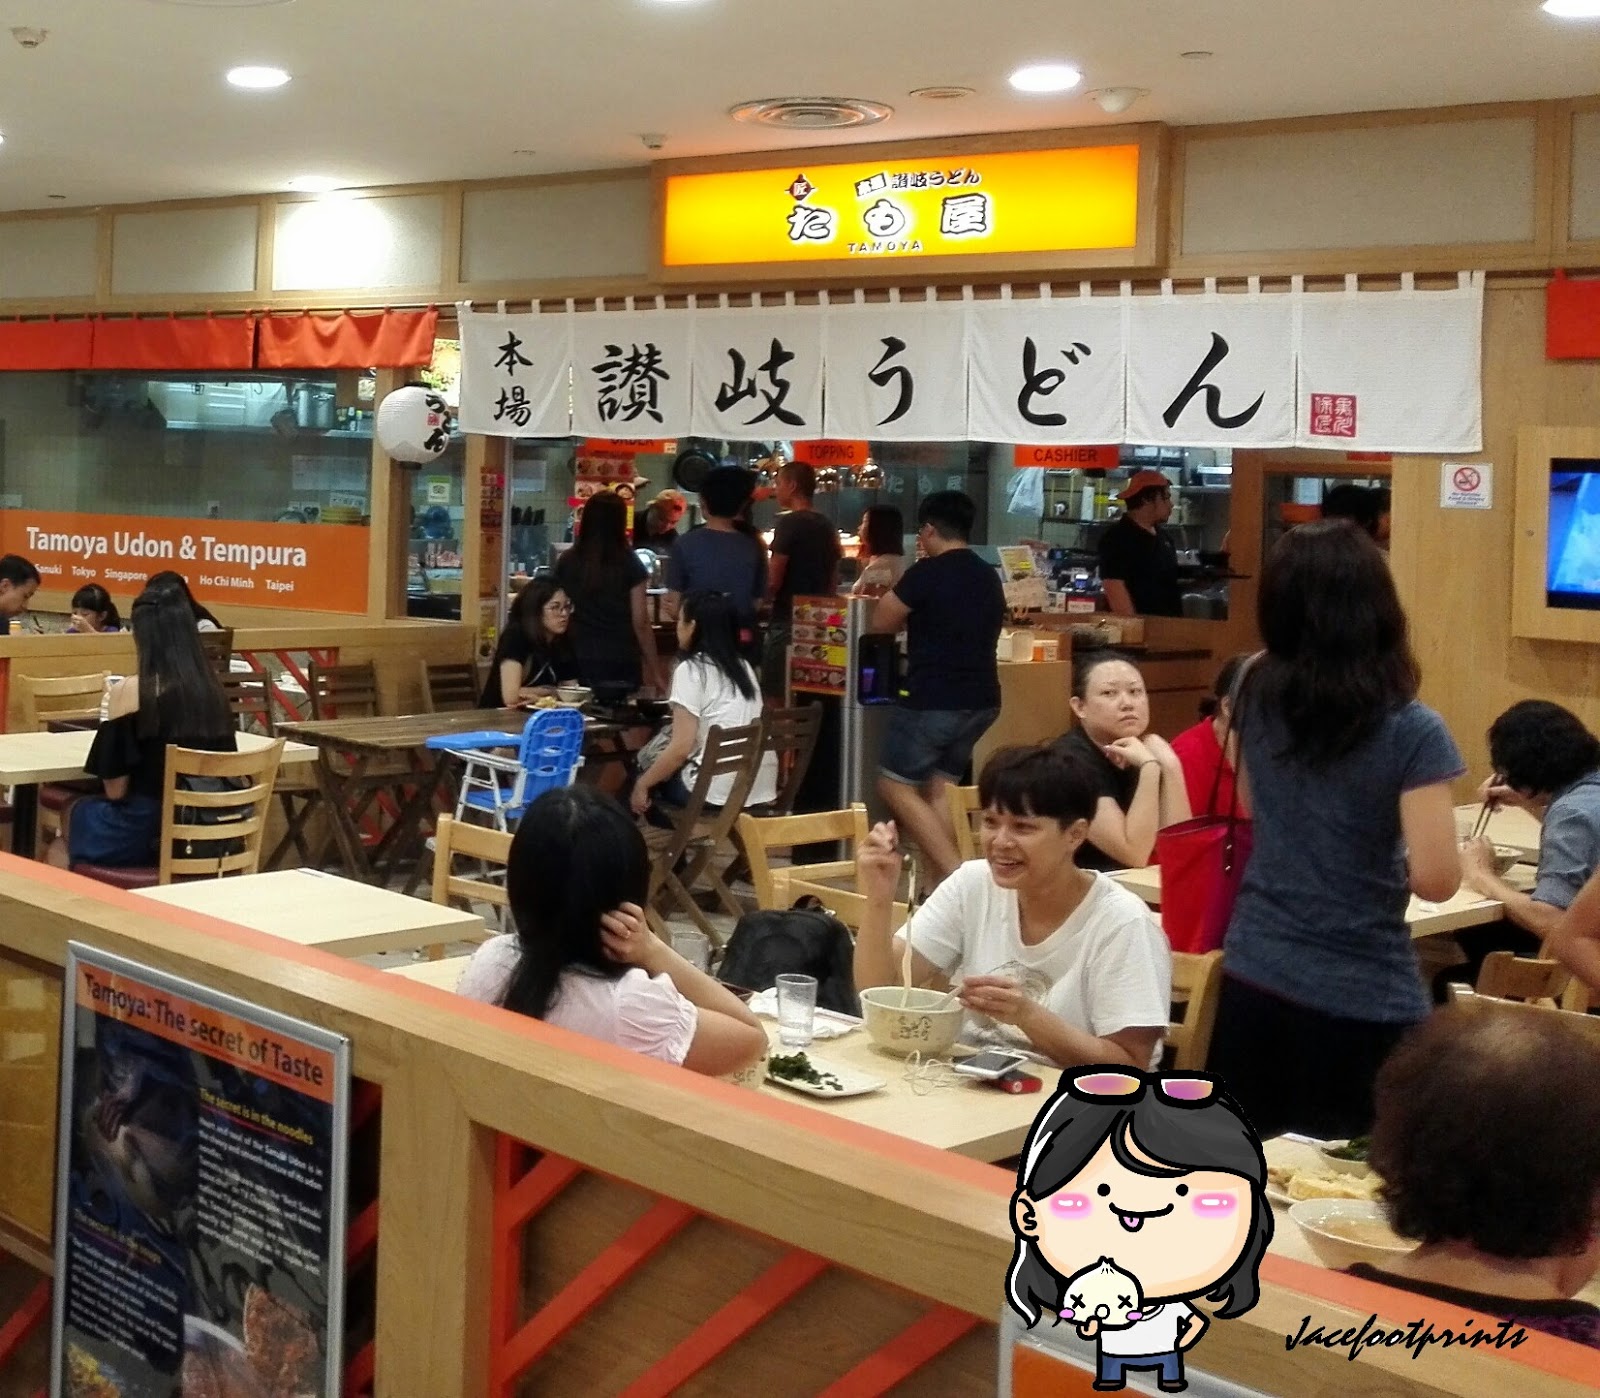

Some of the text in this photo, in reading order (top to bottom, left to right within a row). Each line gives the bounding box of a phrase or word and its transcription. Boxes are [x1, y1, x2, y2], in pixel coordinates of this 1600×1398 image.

[786, 193, 988, 241] たも屋
[848, 239, 922, 253] TAMOYA
[493, 331, 534, 427] 本場
[808, 445, 855, 460] TOPPING
[1033, 448, 1098, 463] CASHIER
[26, 526, 307, 570] Tamoya Udon & Tempura
[72, 565, 97, 578] Tokyo
[105, 568, 149, 582] Singapore
[200, 574, 213, 585] Ho
[214, 575, 230, 588] Chi
[230, 576, 254, 589] Minh
[265, 579, 294, 592] Taipei
[84, 972, 324, 1087] Tamoya: The secret of Taste
